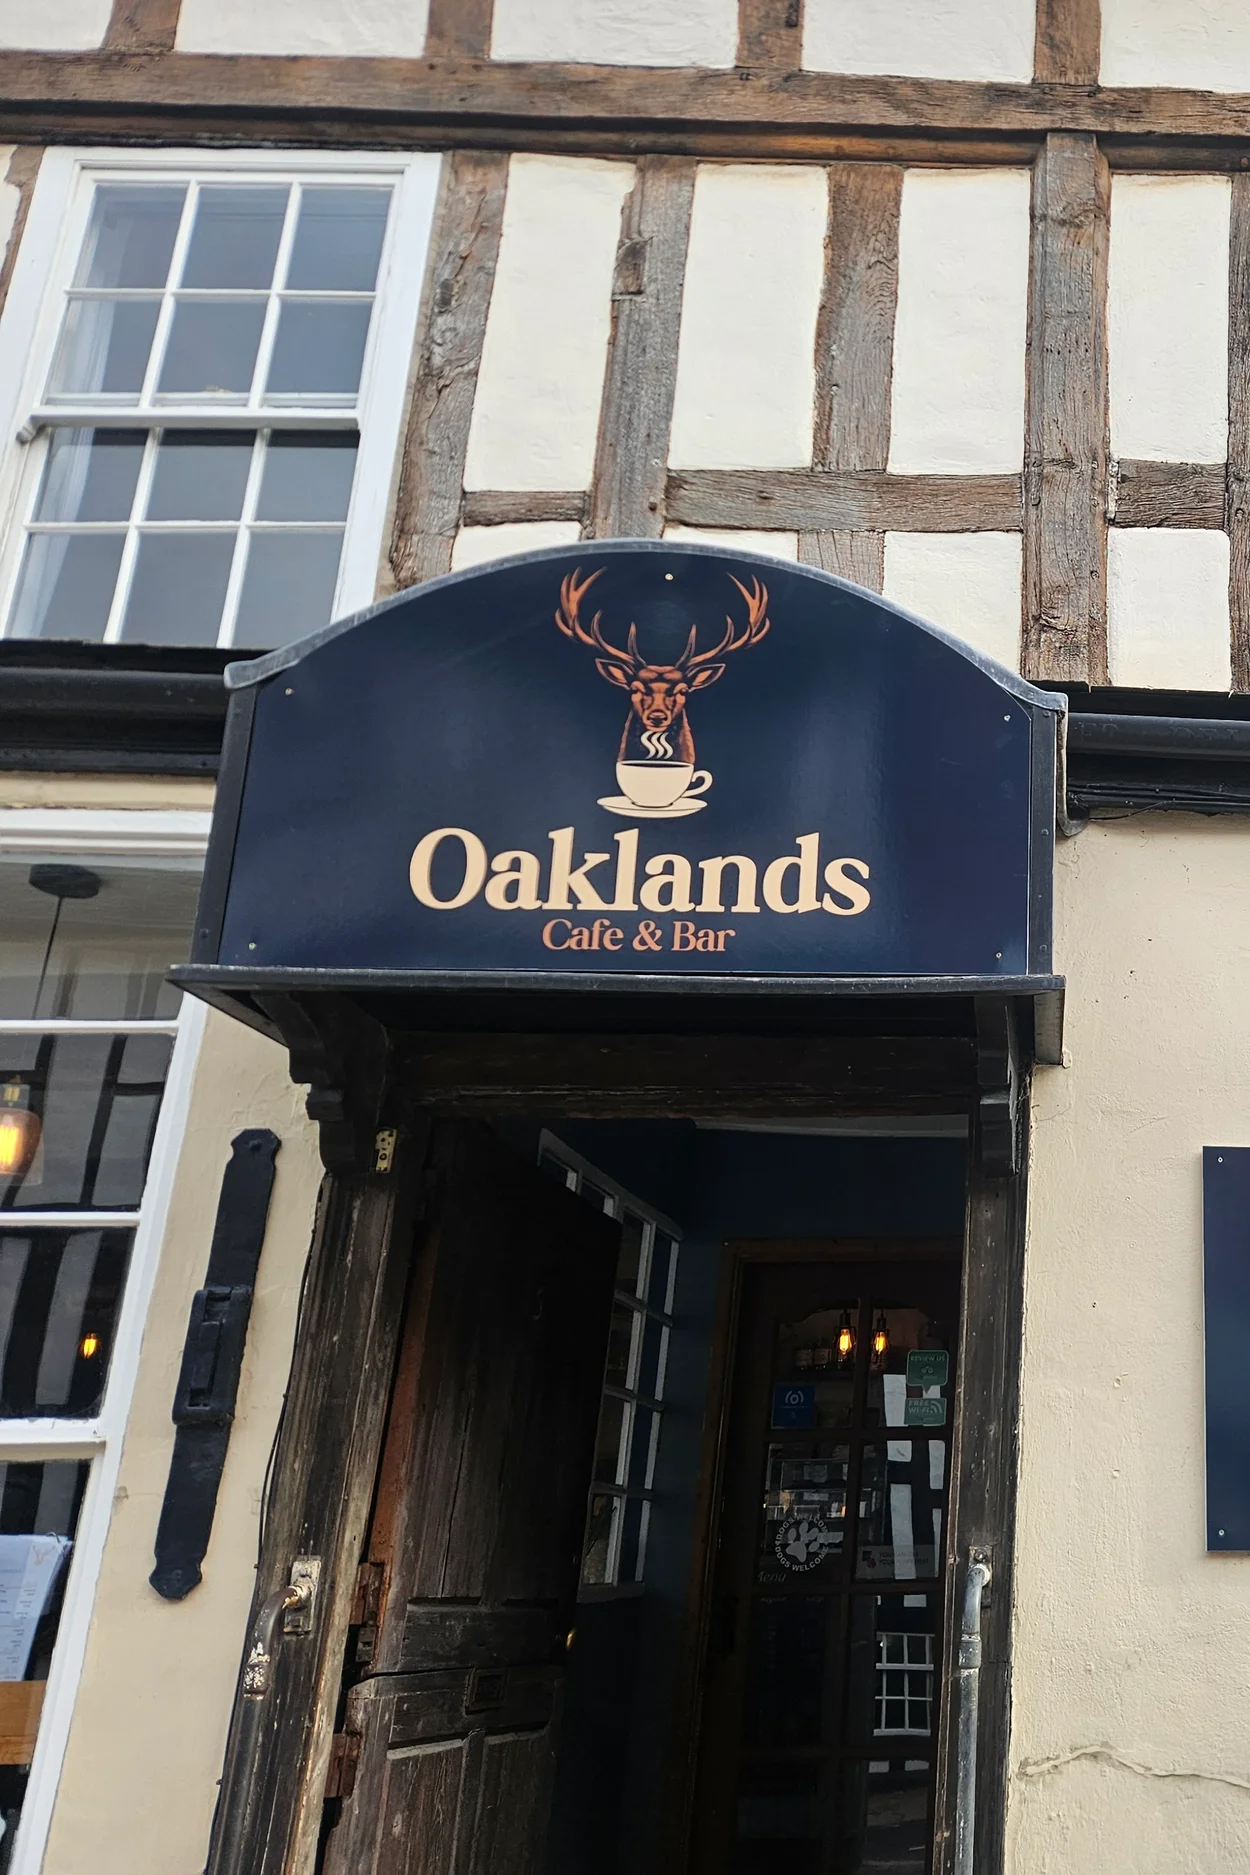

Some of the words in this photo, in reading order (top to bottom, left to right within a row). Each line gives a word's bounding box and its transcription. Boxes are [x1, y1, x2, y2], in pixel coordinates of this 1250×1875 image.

[409, 826, 871, 916] Oaklands
[542, 918, 625, 951] Cafe
[632, 919, 663, 952] &
[670, 920, 736, 952] Bar
[776, 1516, 795, 1540] DOGS
[774, 1546, 791, 1568] DOGS
